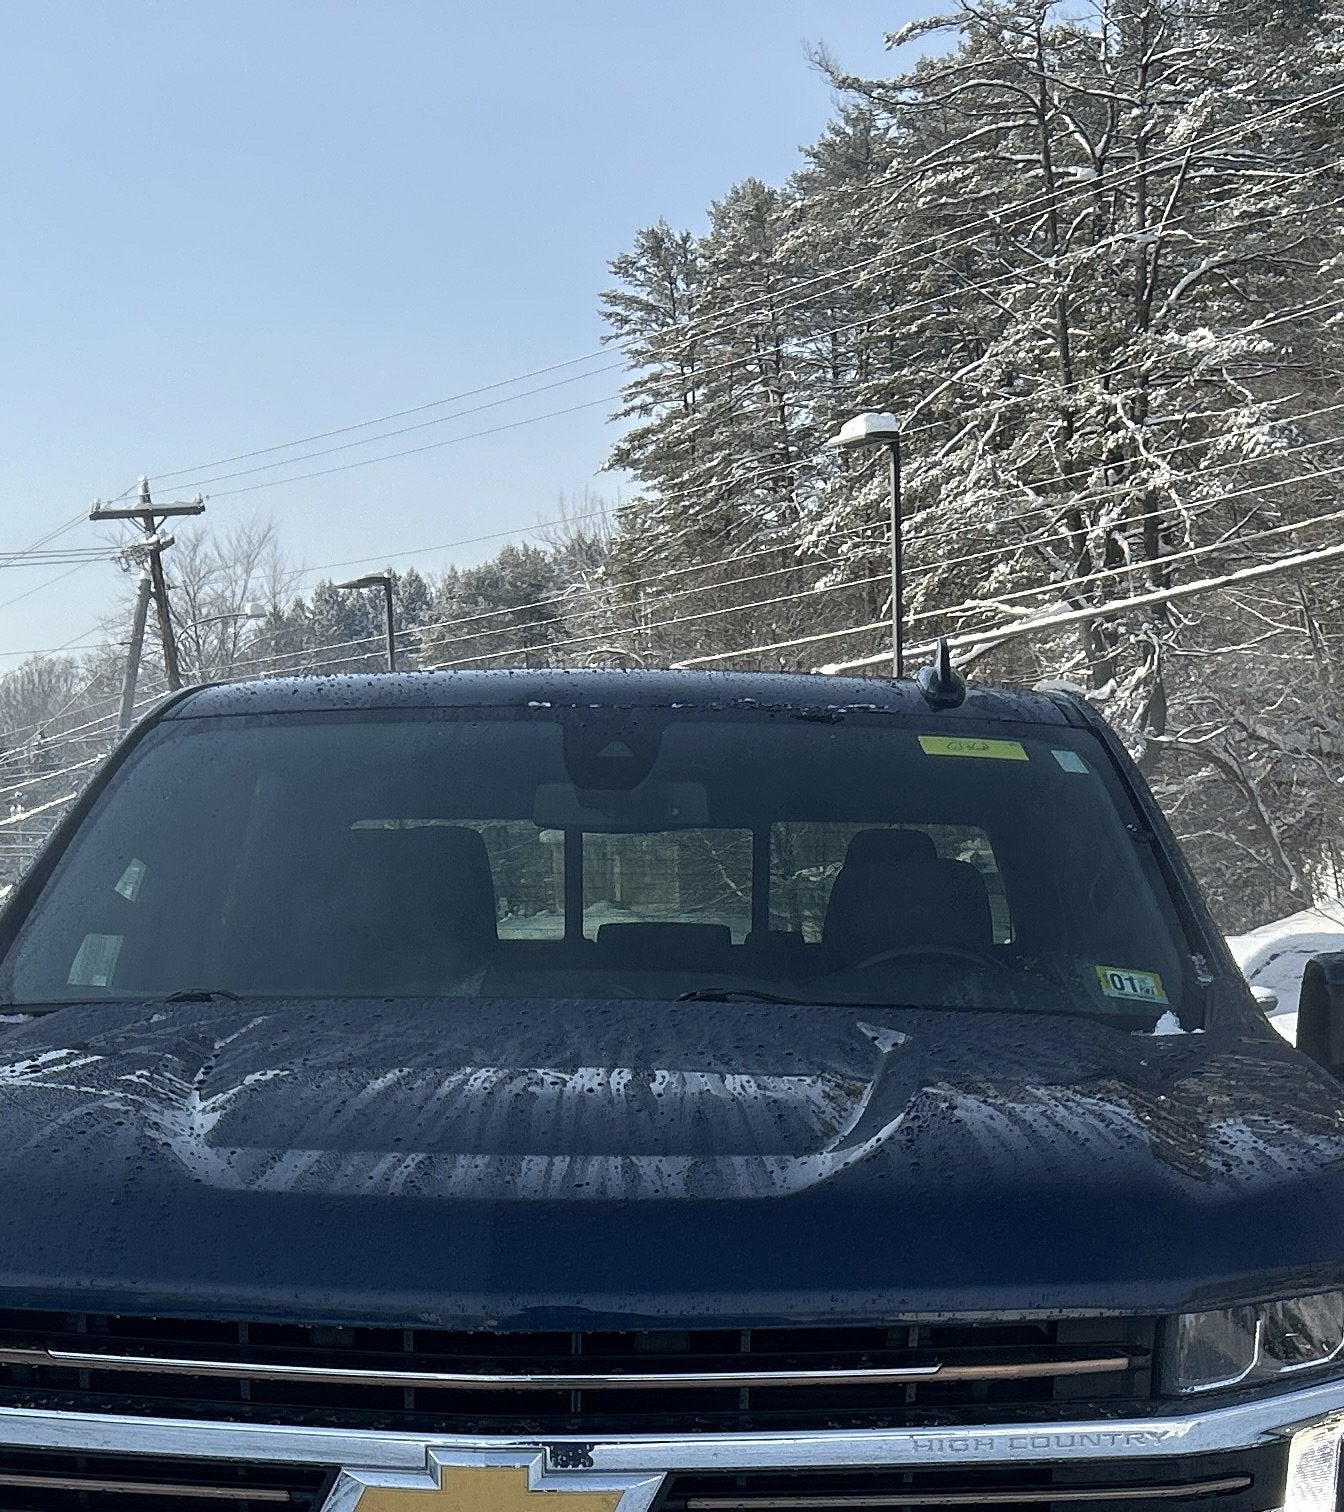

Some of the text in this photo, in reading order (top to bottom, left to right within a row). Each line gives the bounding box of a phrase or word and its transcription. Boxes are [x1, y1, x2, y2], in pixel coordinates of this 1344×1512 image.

[1109, 973, 1138, 993] 01
[912, 1429, 1170, 1453] HIGH COUNTRY
